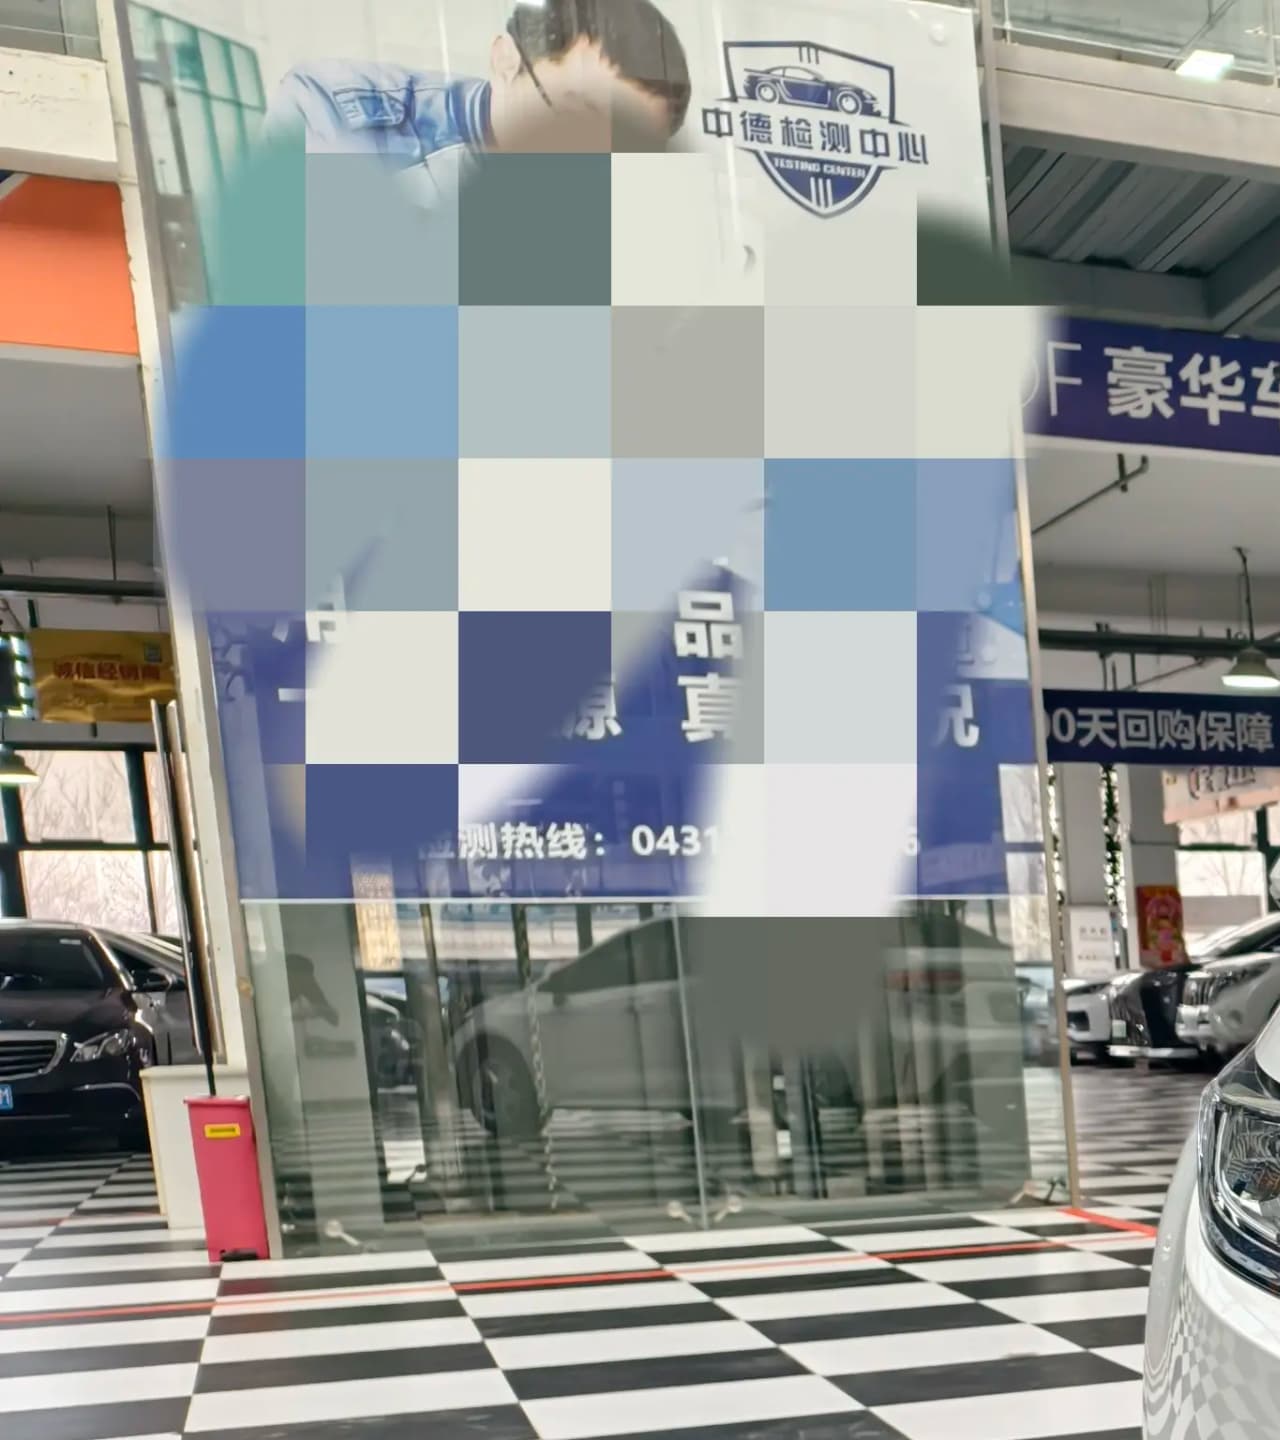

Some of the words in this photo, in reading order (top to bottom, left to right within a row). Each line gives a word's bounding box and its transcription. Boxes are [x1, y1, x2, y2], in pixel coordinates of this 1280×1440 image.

[702, 107, 929, 165] 中德检测中心
[774, 157, 820, 174] TESTING
[823, 164, 867, 179] CENTER
[1046, 707, 1274, 752] 0天回购保障
[418, 822, 606, 861] 测热线：
